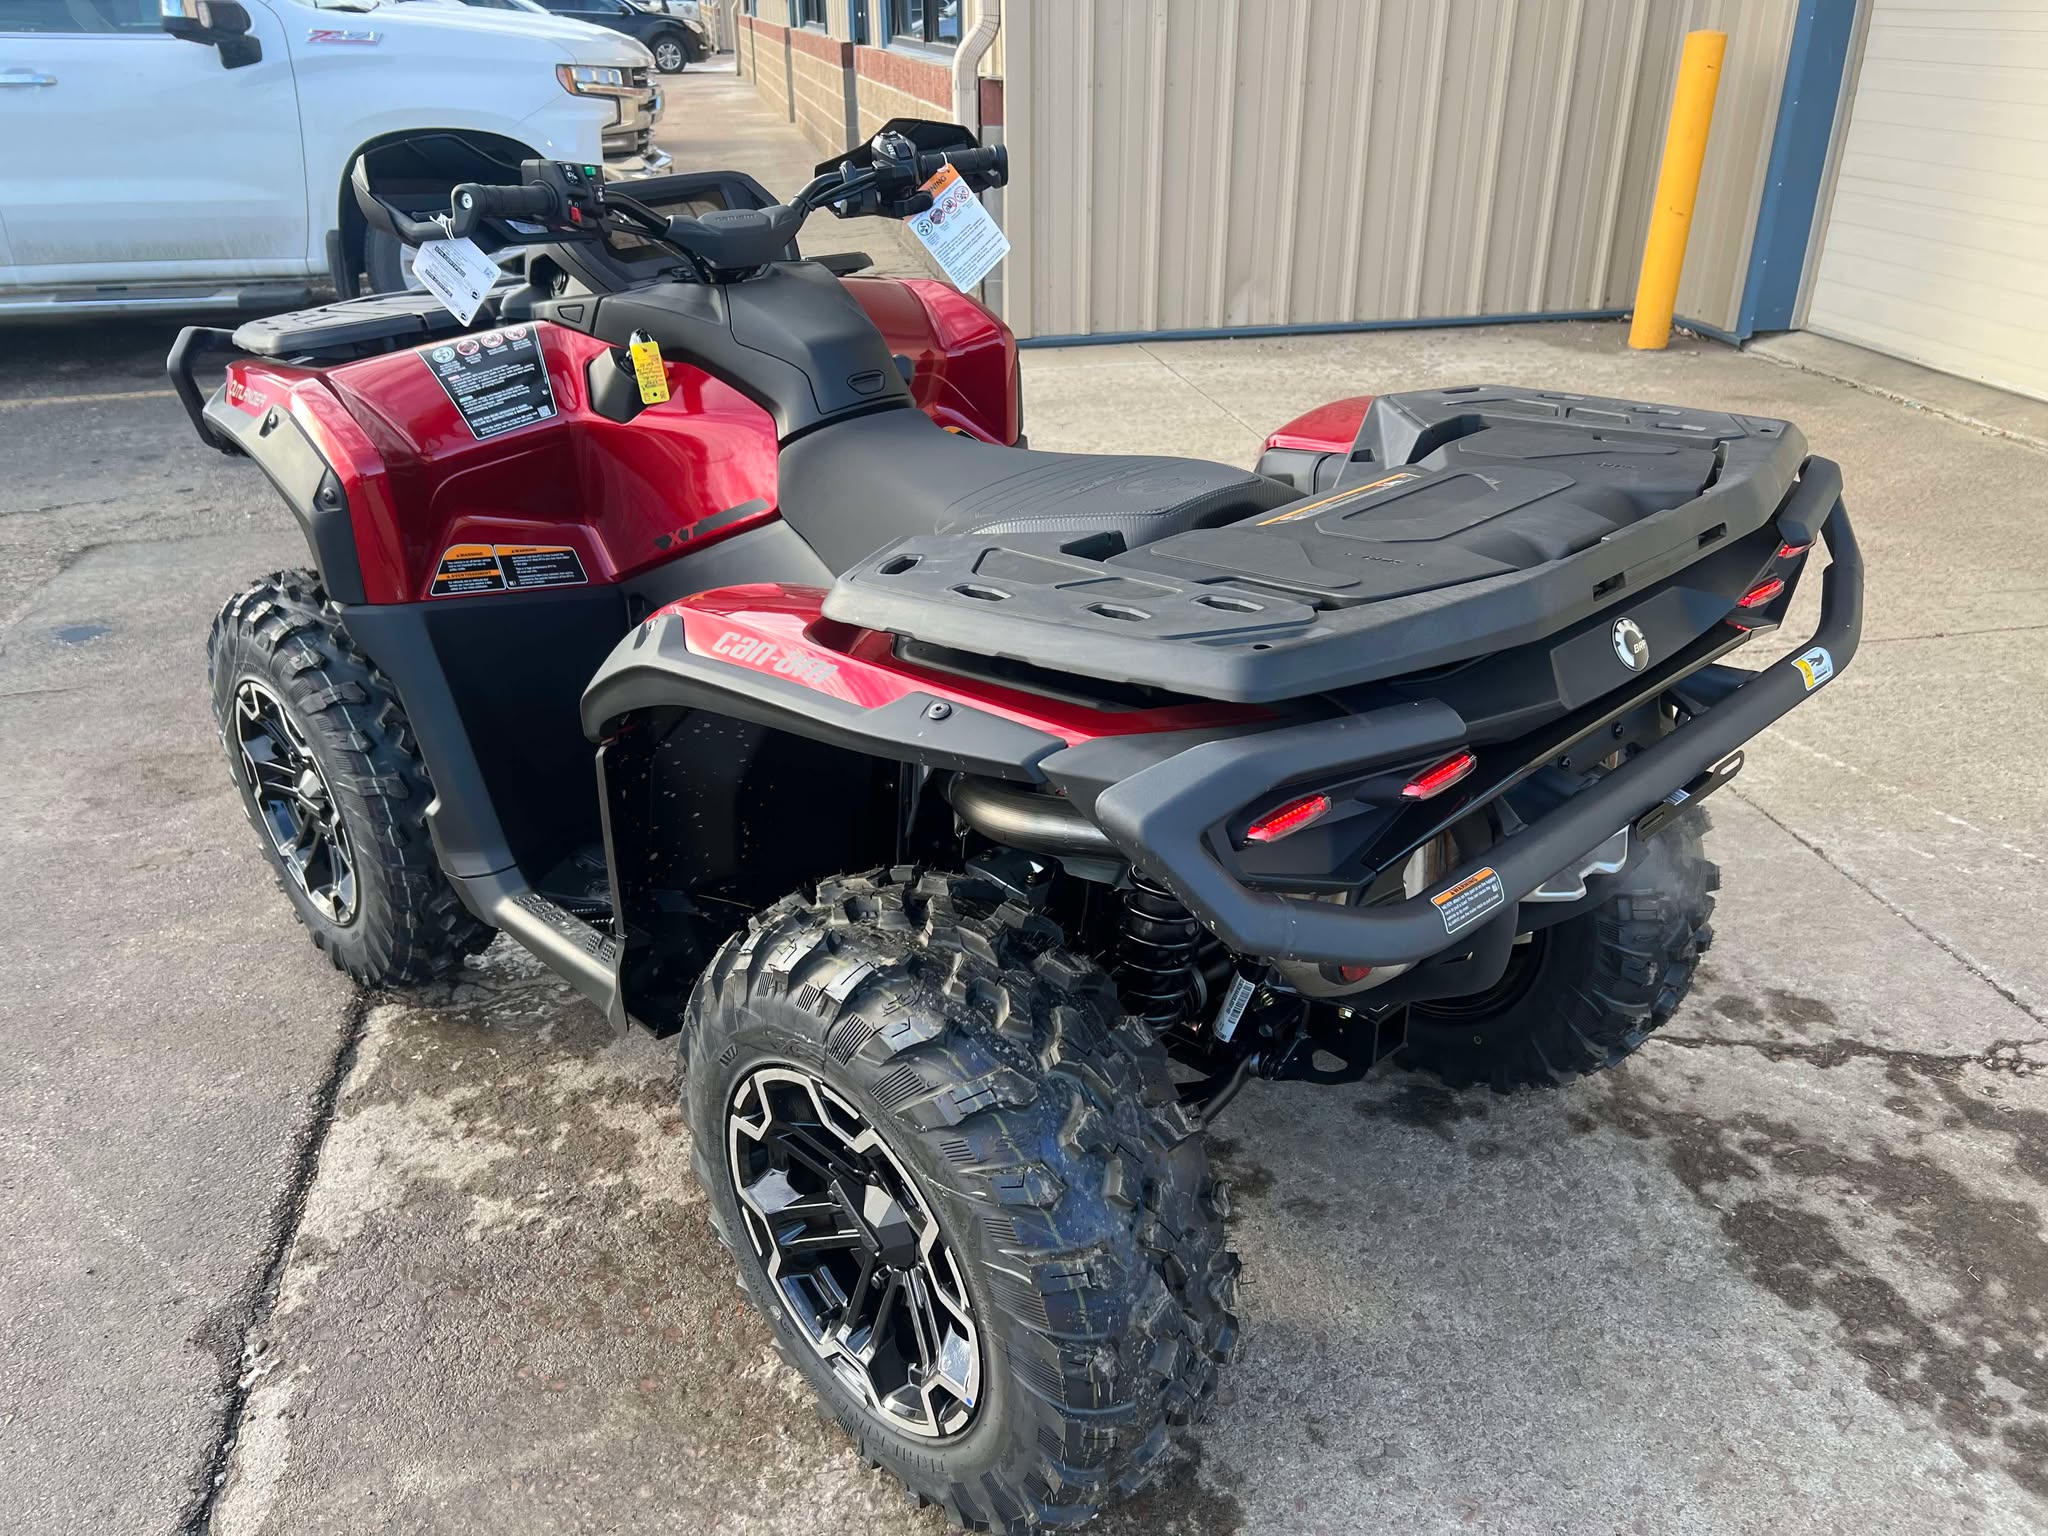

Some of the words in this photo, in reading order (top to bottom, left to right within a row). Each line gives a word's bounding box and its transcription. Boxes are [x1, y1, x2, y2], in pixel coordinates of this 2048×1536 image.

[230, 380, 267, 408] OUTLANDER
[668, 521, 699, 547] XT
[712, 631, 840, 683] can-am
[1633, 639, 1646, 654] BRP
